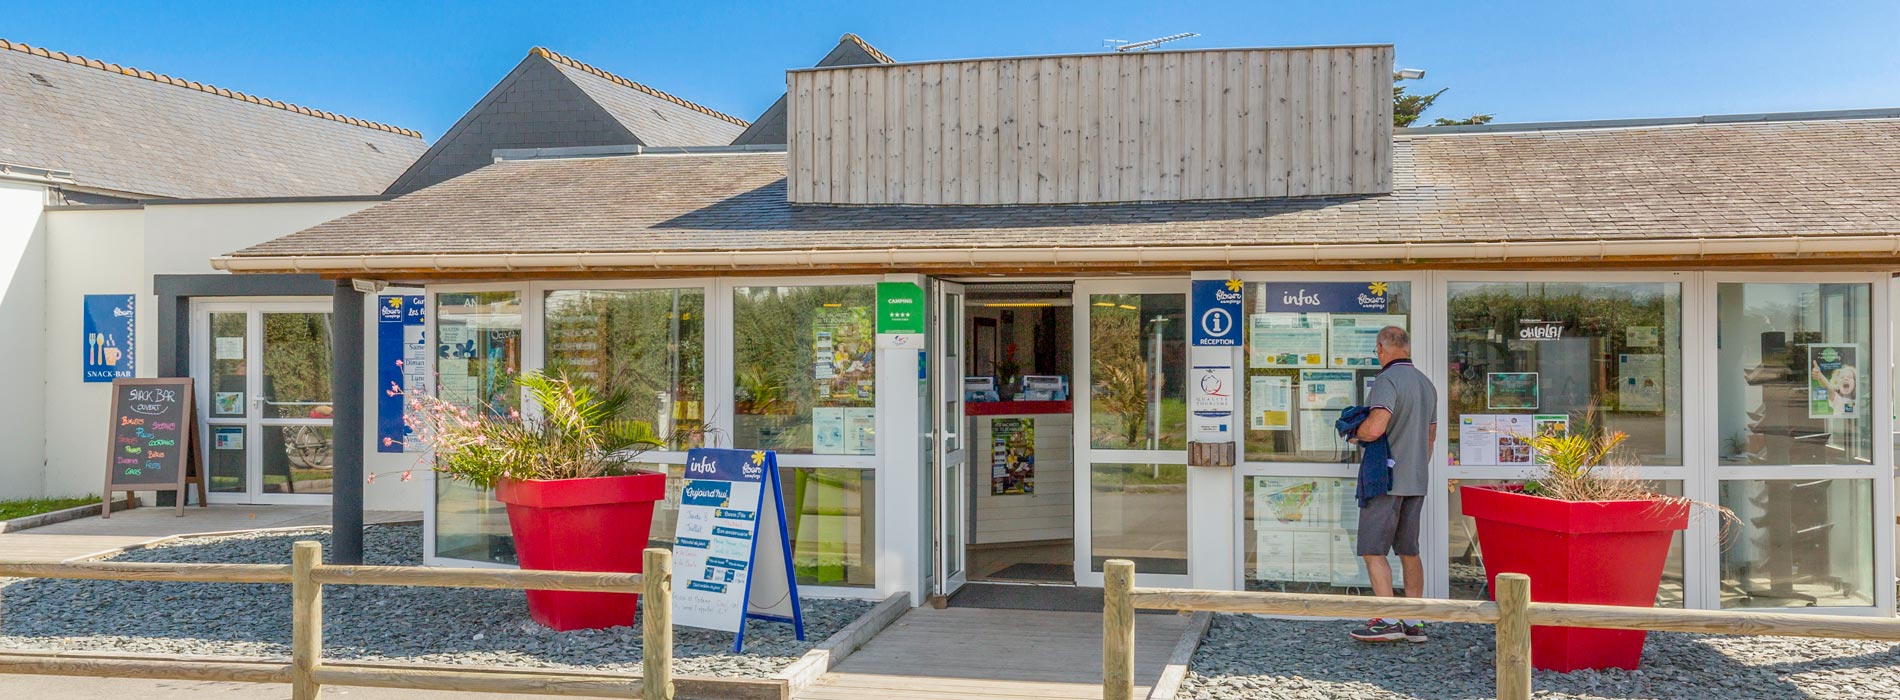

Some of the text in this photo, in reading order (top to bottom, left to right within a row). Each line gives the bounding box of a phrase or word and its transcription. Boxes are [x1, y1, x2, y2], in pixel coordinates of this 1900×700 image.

[1283, 289, 1320, 306] infos
[87, 370, 131, 378] SNACK-BAR
[128, 388, 175, 402] SNACK BAR
[137, 403, 161, 411] OUVERT
[690, 456, 716, 474] infos
